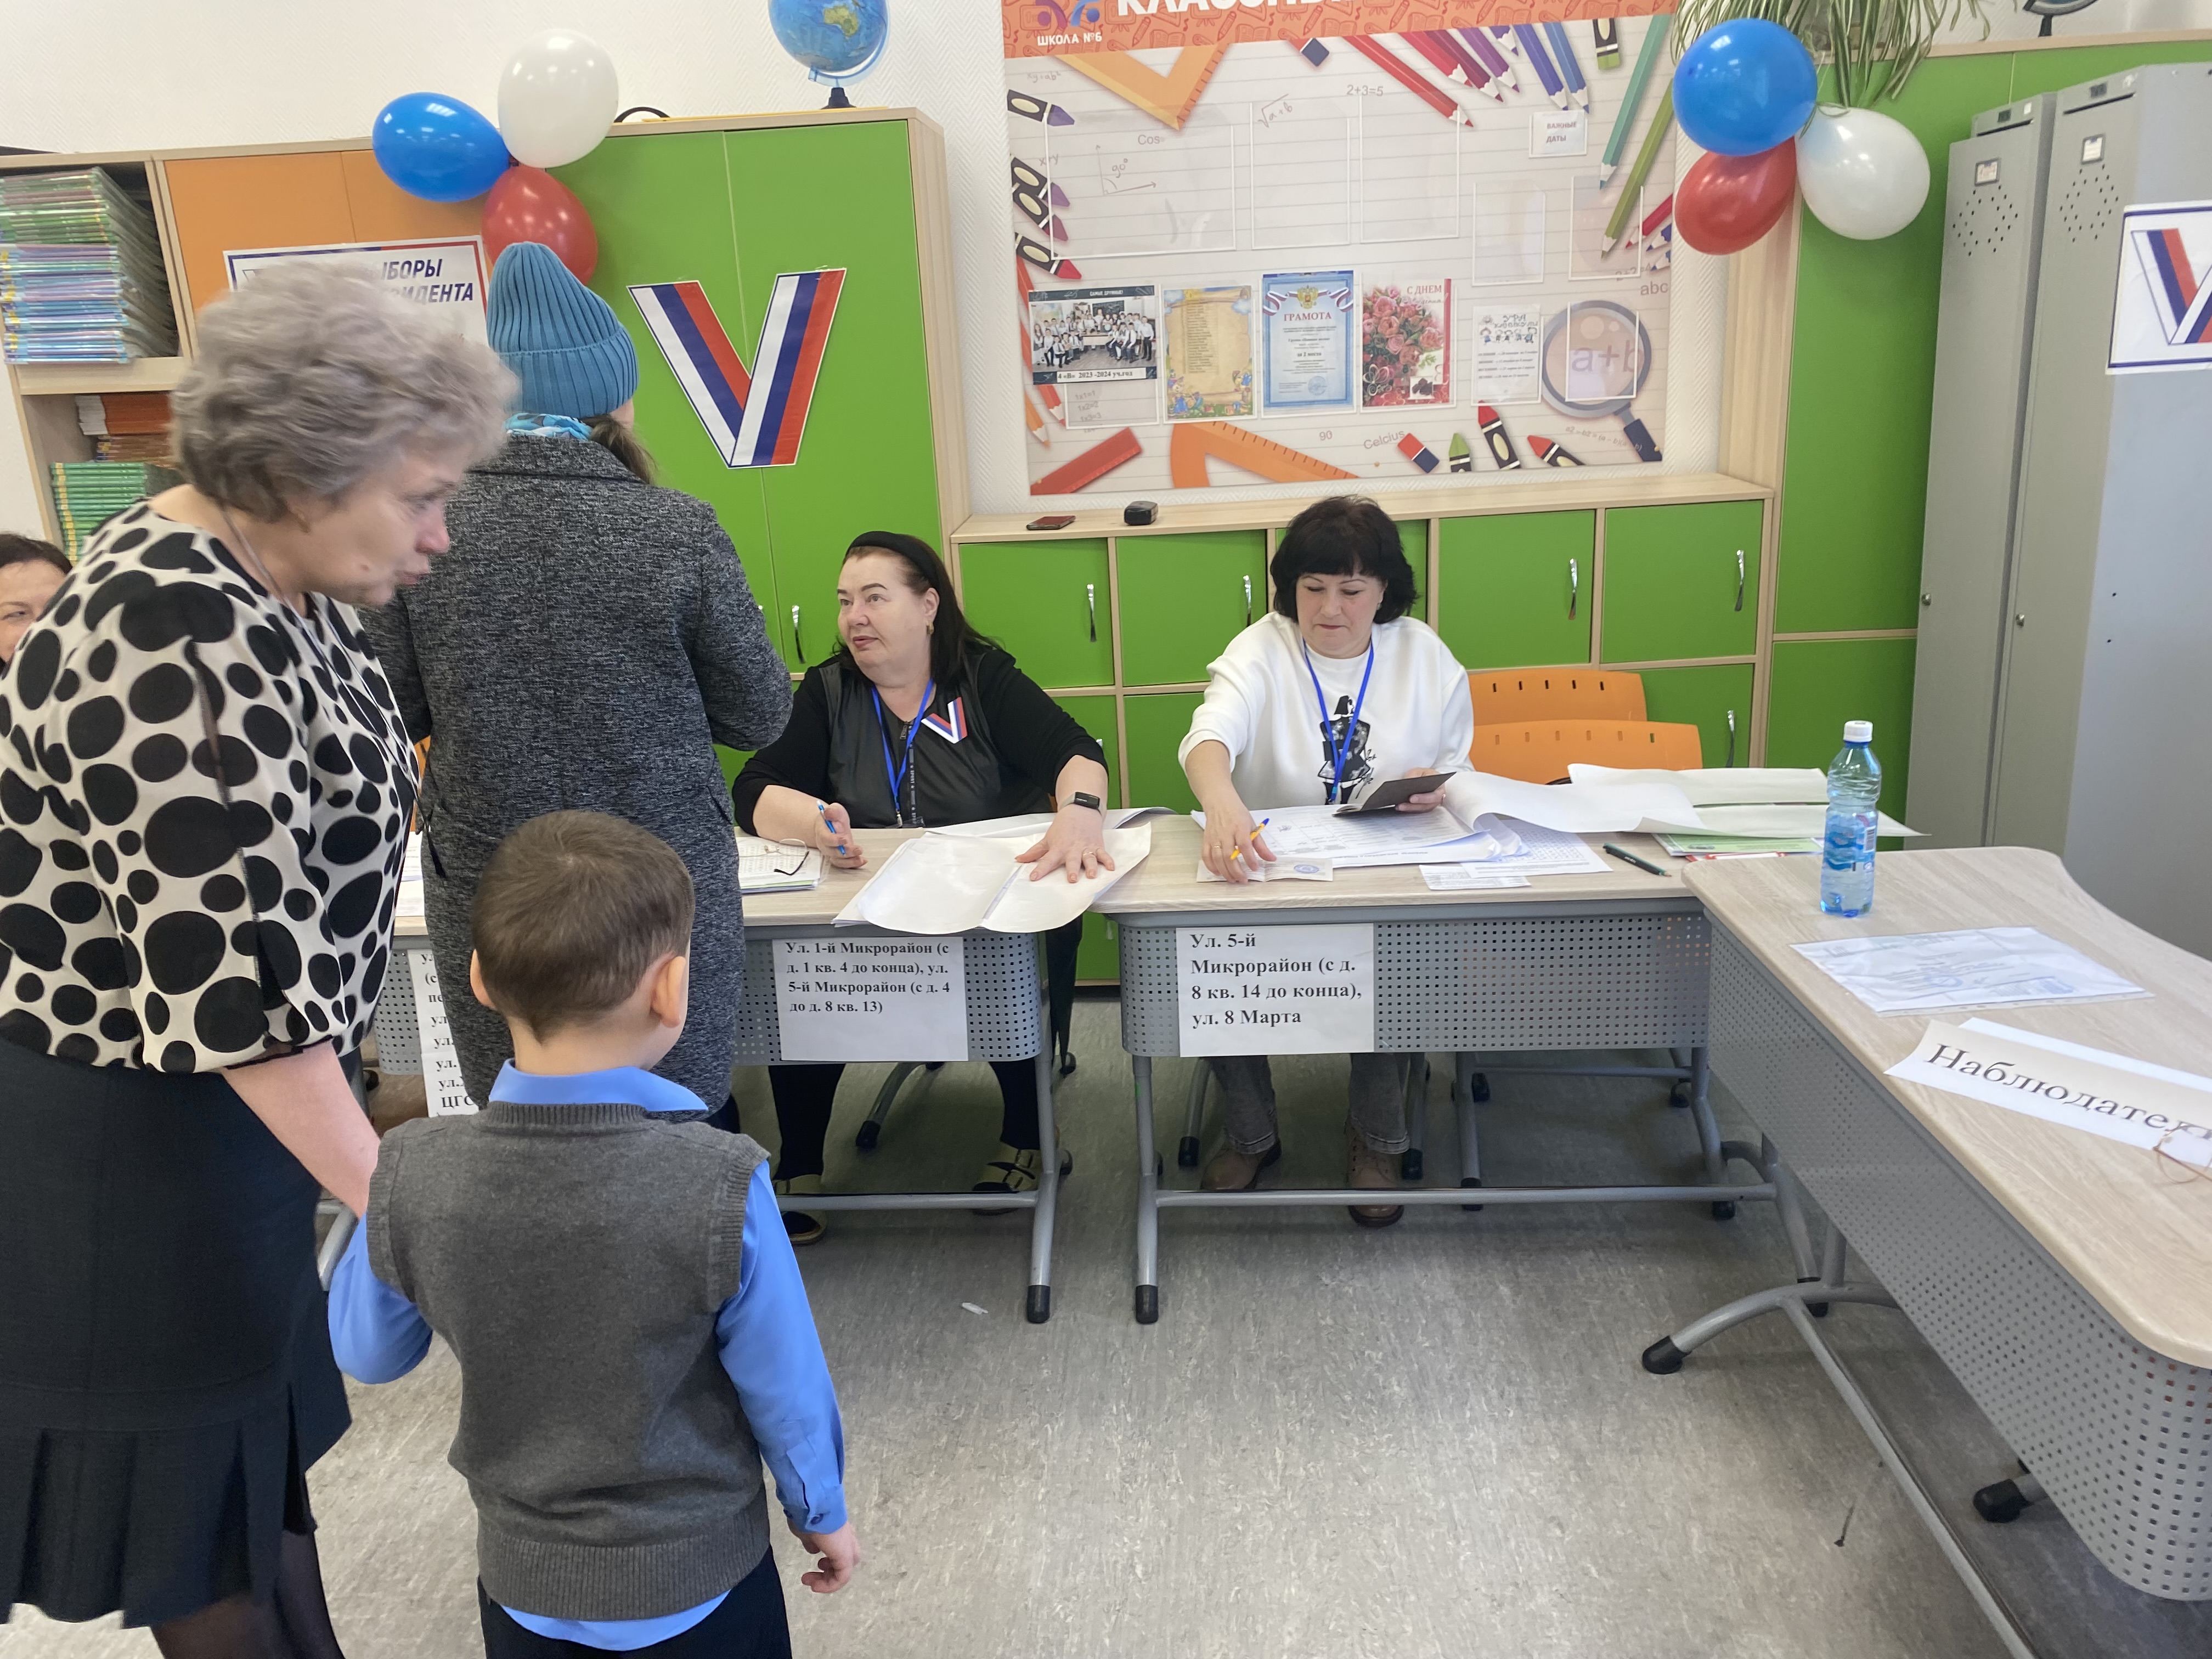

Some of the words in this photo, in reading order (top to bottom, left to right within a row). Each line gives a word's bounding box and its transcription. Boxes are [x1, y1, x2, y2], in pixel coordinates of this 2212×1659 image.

[1037, 33, 1079, 46] ШКОЛА
[1346, 84, 1384, 96] 2+3=5
[1547, 121, 1577, 129] ВАЖНЫЕ
[1407, 286, 1413, 294] С
[1414, 285, 1442, 295] ДНЕМ
[1640, 280, 1668, 296] abc
[1284, 312, 1332, 321] ГРАМОТА
[1319, 430, 1333, 441] 90
[1363, 431, 1405, 449] Celcius
[1189, 934, 1221, 948] Ул.
[1227, 933, 1256, 947] 5-й
[786, 943, 810, 953] Ул.
[815, 943, 836, 953] 1-й
[840, 943, 932, 956] Микрорайон
[937, 943, 949, 956] (с
[787, 965, 799, 973] д.
[803, 962, 809, 972] 1
[840, 962, 848, 972] 4
[851, 964, 868, 974] до
[872, 962, 924, 975] конца),
[928, 965, 948, 975] ул.
[1190, 958, 1312, 977] Микрорайон
[1318, 957, 1334, 975] (с
[1339, 961, 1355, 973] д.
[425, 973, 437, 986] (с
[788, 981, 810, 992] 5-й
[815, 981, 906, 995] Микрорайон
[911, 981, 923, 995] (с
[926, 985, 938, 993] д.
[943, 982, 950, 992] 4
[1192, 985, 1201, 1000] 8
[1207, 989, 1234, 999] кв.
[1242, 984, 1261, 998] 14
[1266, 988, 1286, 1000] до
[1293, 983, 1362, 1000] конца),
[789, 1003, 805, 1013] до
[809, 1003, 821, 1013] д.
[825, 1001, 833, 1012] 8
[862, 1001, 883, 1014] 13)
[1192, 1015, 1219, 1029] ул.
[1224, 1010, 1234, 1024] 8
[1240, 1009, 1301, 1027] Марта
[436, 1060, 457, 1071] ул.
